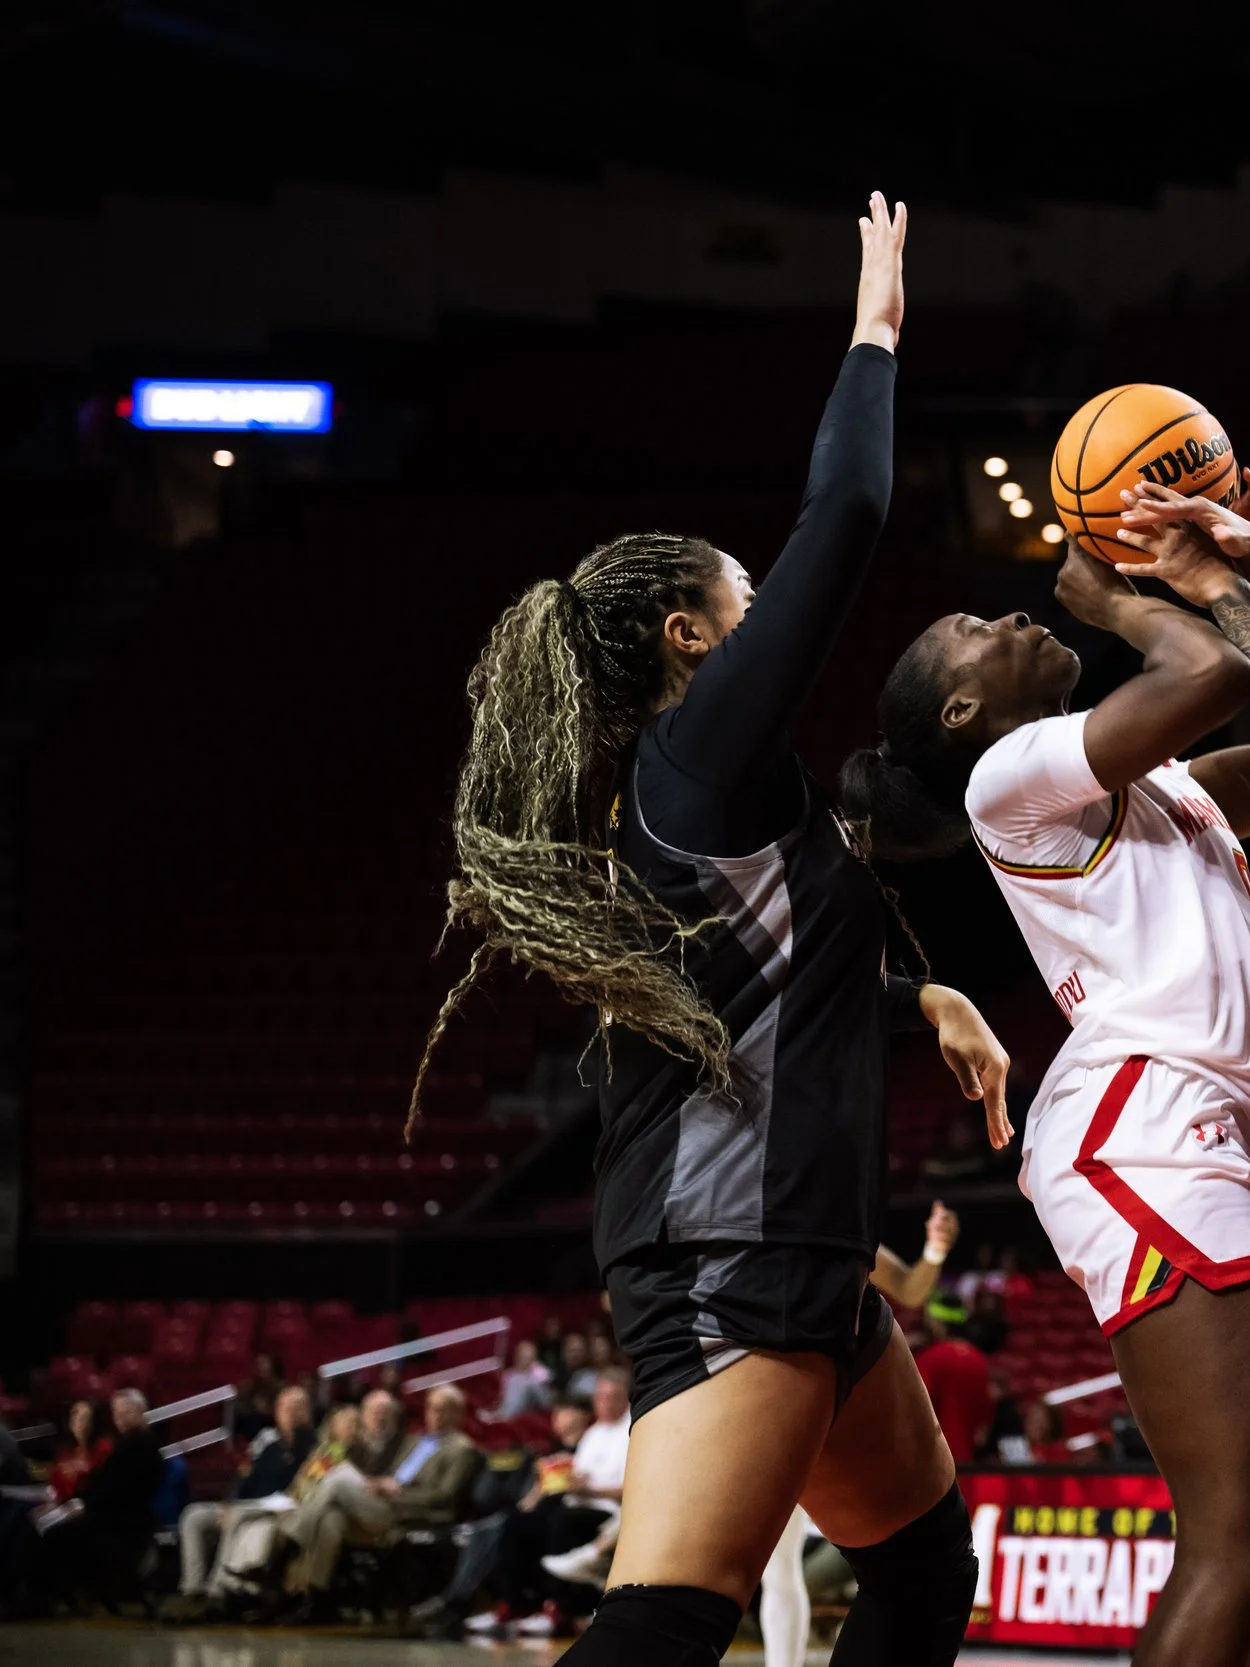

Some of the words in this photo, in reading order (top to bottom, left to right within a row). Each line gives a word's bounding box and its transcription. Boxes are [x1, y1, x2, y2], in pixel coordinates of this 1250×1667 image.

[1137, 434, 1232, 487] Wilson
[1191, 469, 1207, 481] EVO
[1207, 461, 1220, 474] NXT
[1014, 1507, 1098, 1536] HOME
[1112, 1508, 1156, 1537] OF
